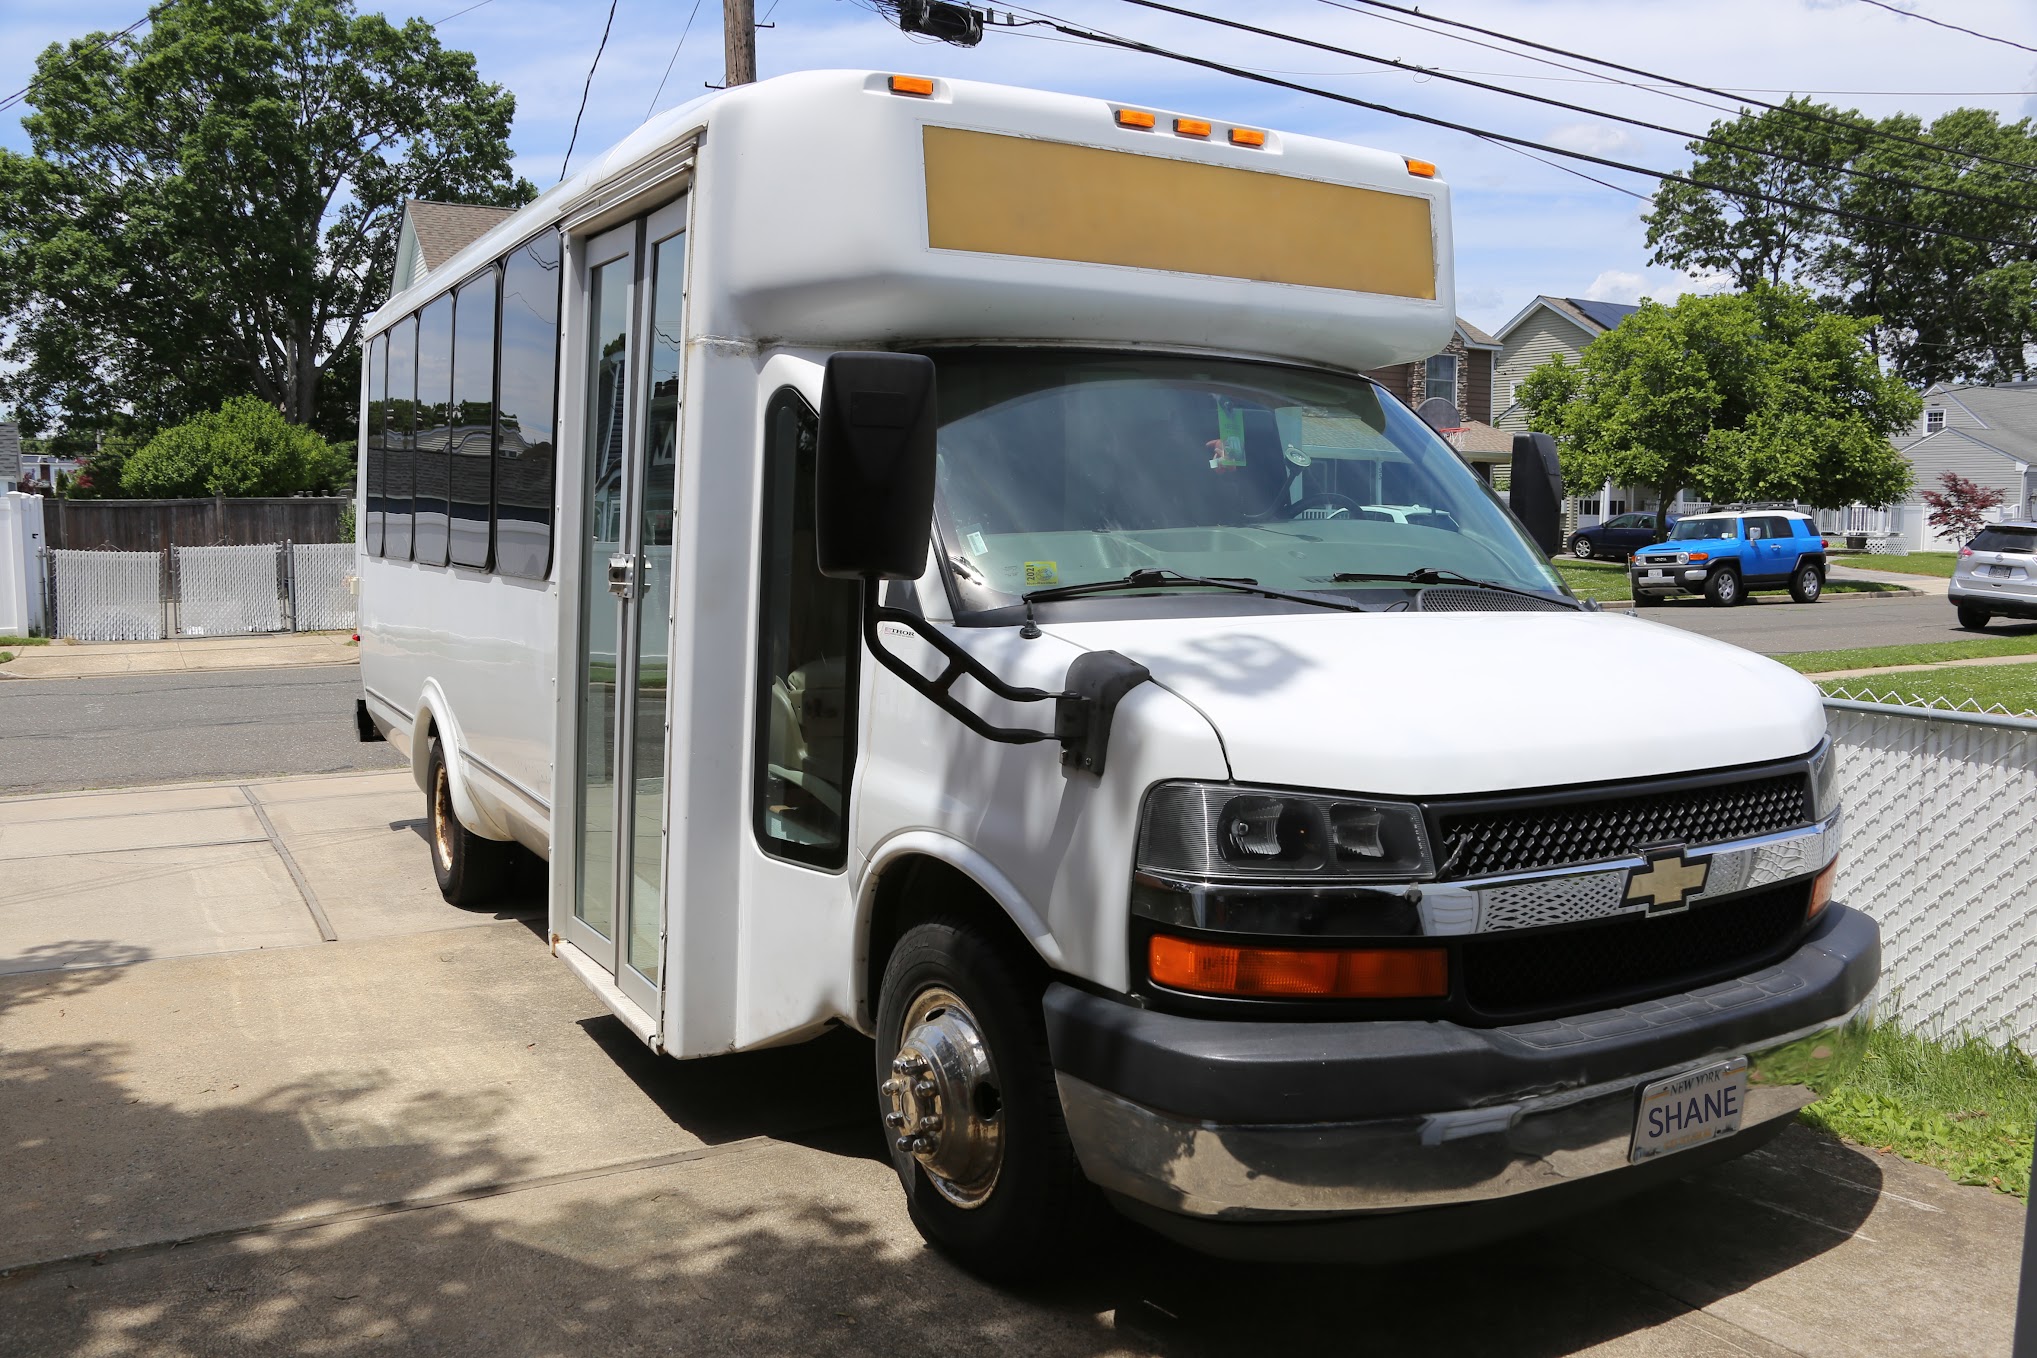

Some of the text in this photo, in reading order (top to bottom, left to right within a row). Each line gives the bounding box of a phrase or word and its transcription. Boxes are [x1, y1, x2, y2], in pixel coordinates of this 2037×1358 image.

[1025, 564, 1035, 581] 2021
[1670, 1069, 1722, 1096] NEW YORK
[1648, 1086, 1738, 1138] SHANE
